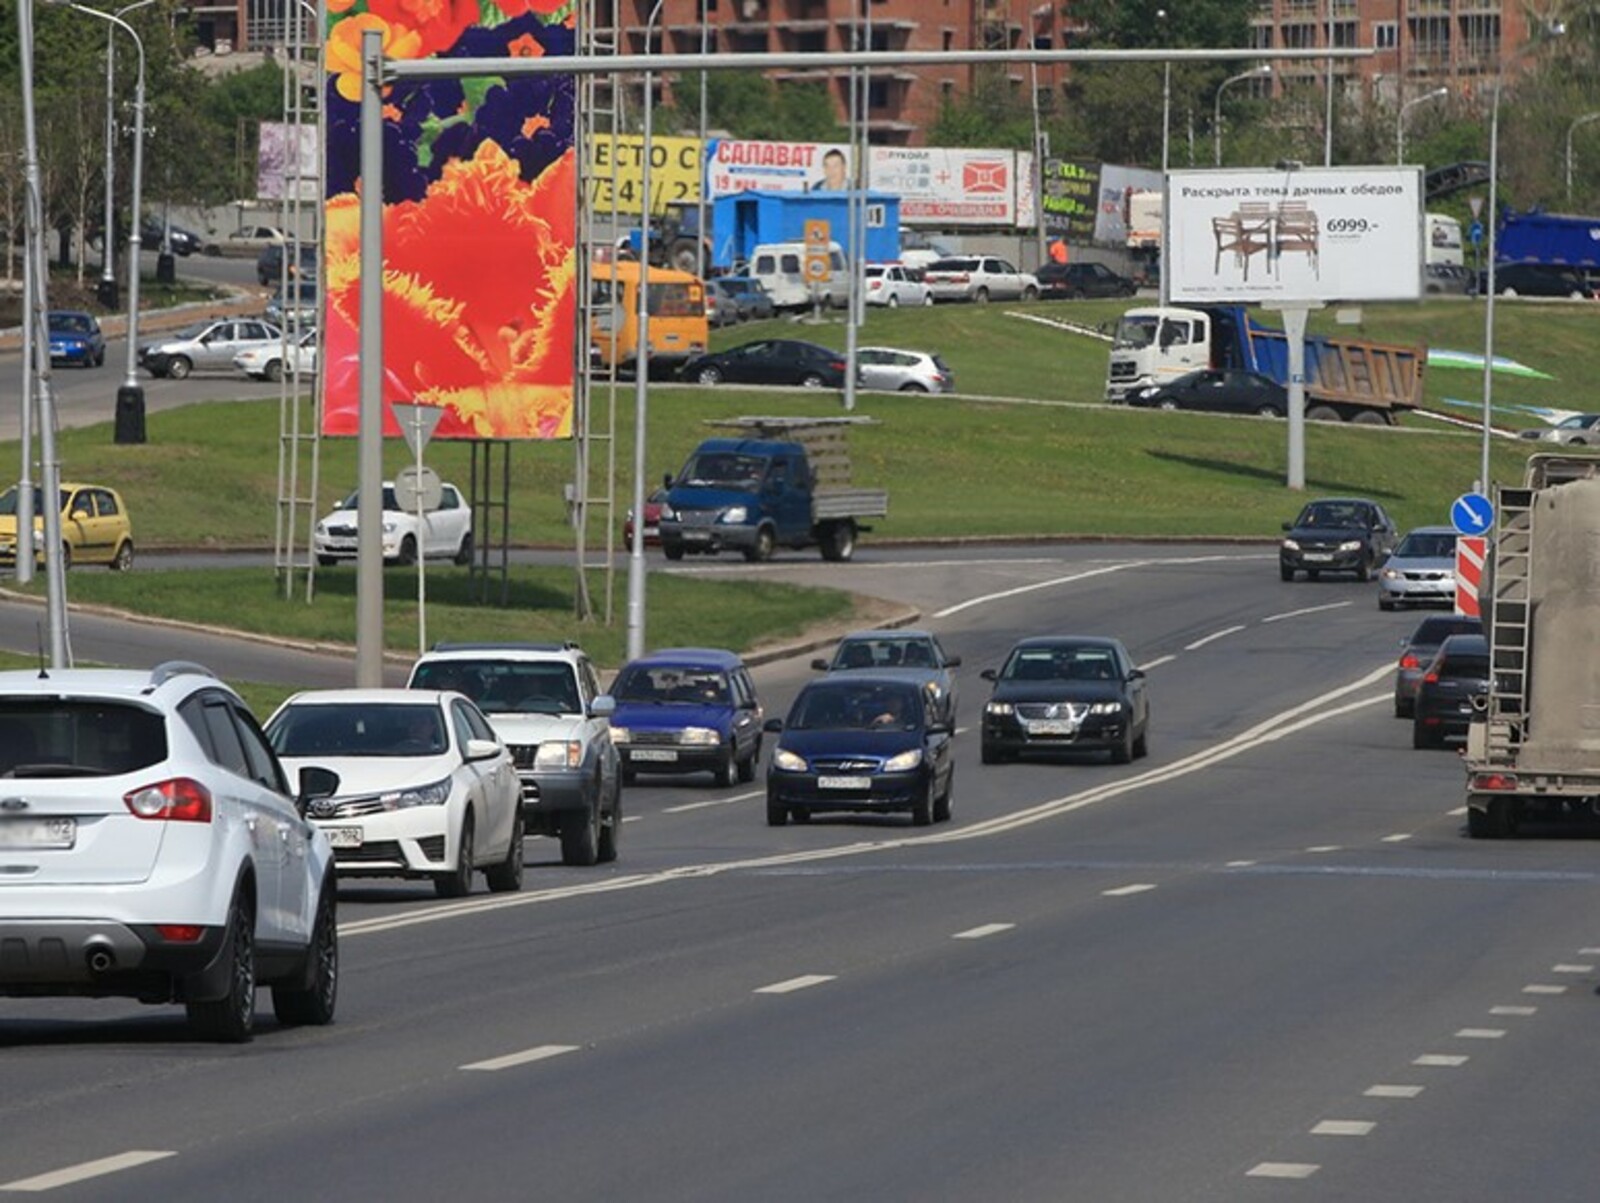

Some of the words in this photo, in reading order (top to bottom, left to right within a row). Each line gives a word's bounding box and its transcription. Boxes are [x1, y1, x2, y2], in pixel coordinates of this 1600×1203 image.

[584, 143, 667, 168] ЕСТО
[679, 146, 701, 169] С
[718, 142, 816, 167] САЛАВАТ
[1182, 187, 1250, 199] Раскрыта
[1255, 187, 1289, 197] тема
[1293, 187, 1347, 197] дачных
[1351, 183, 1404, 196] обедов
[1326, 217, 1379, 233] 6999.-
